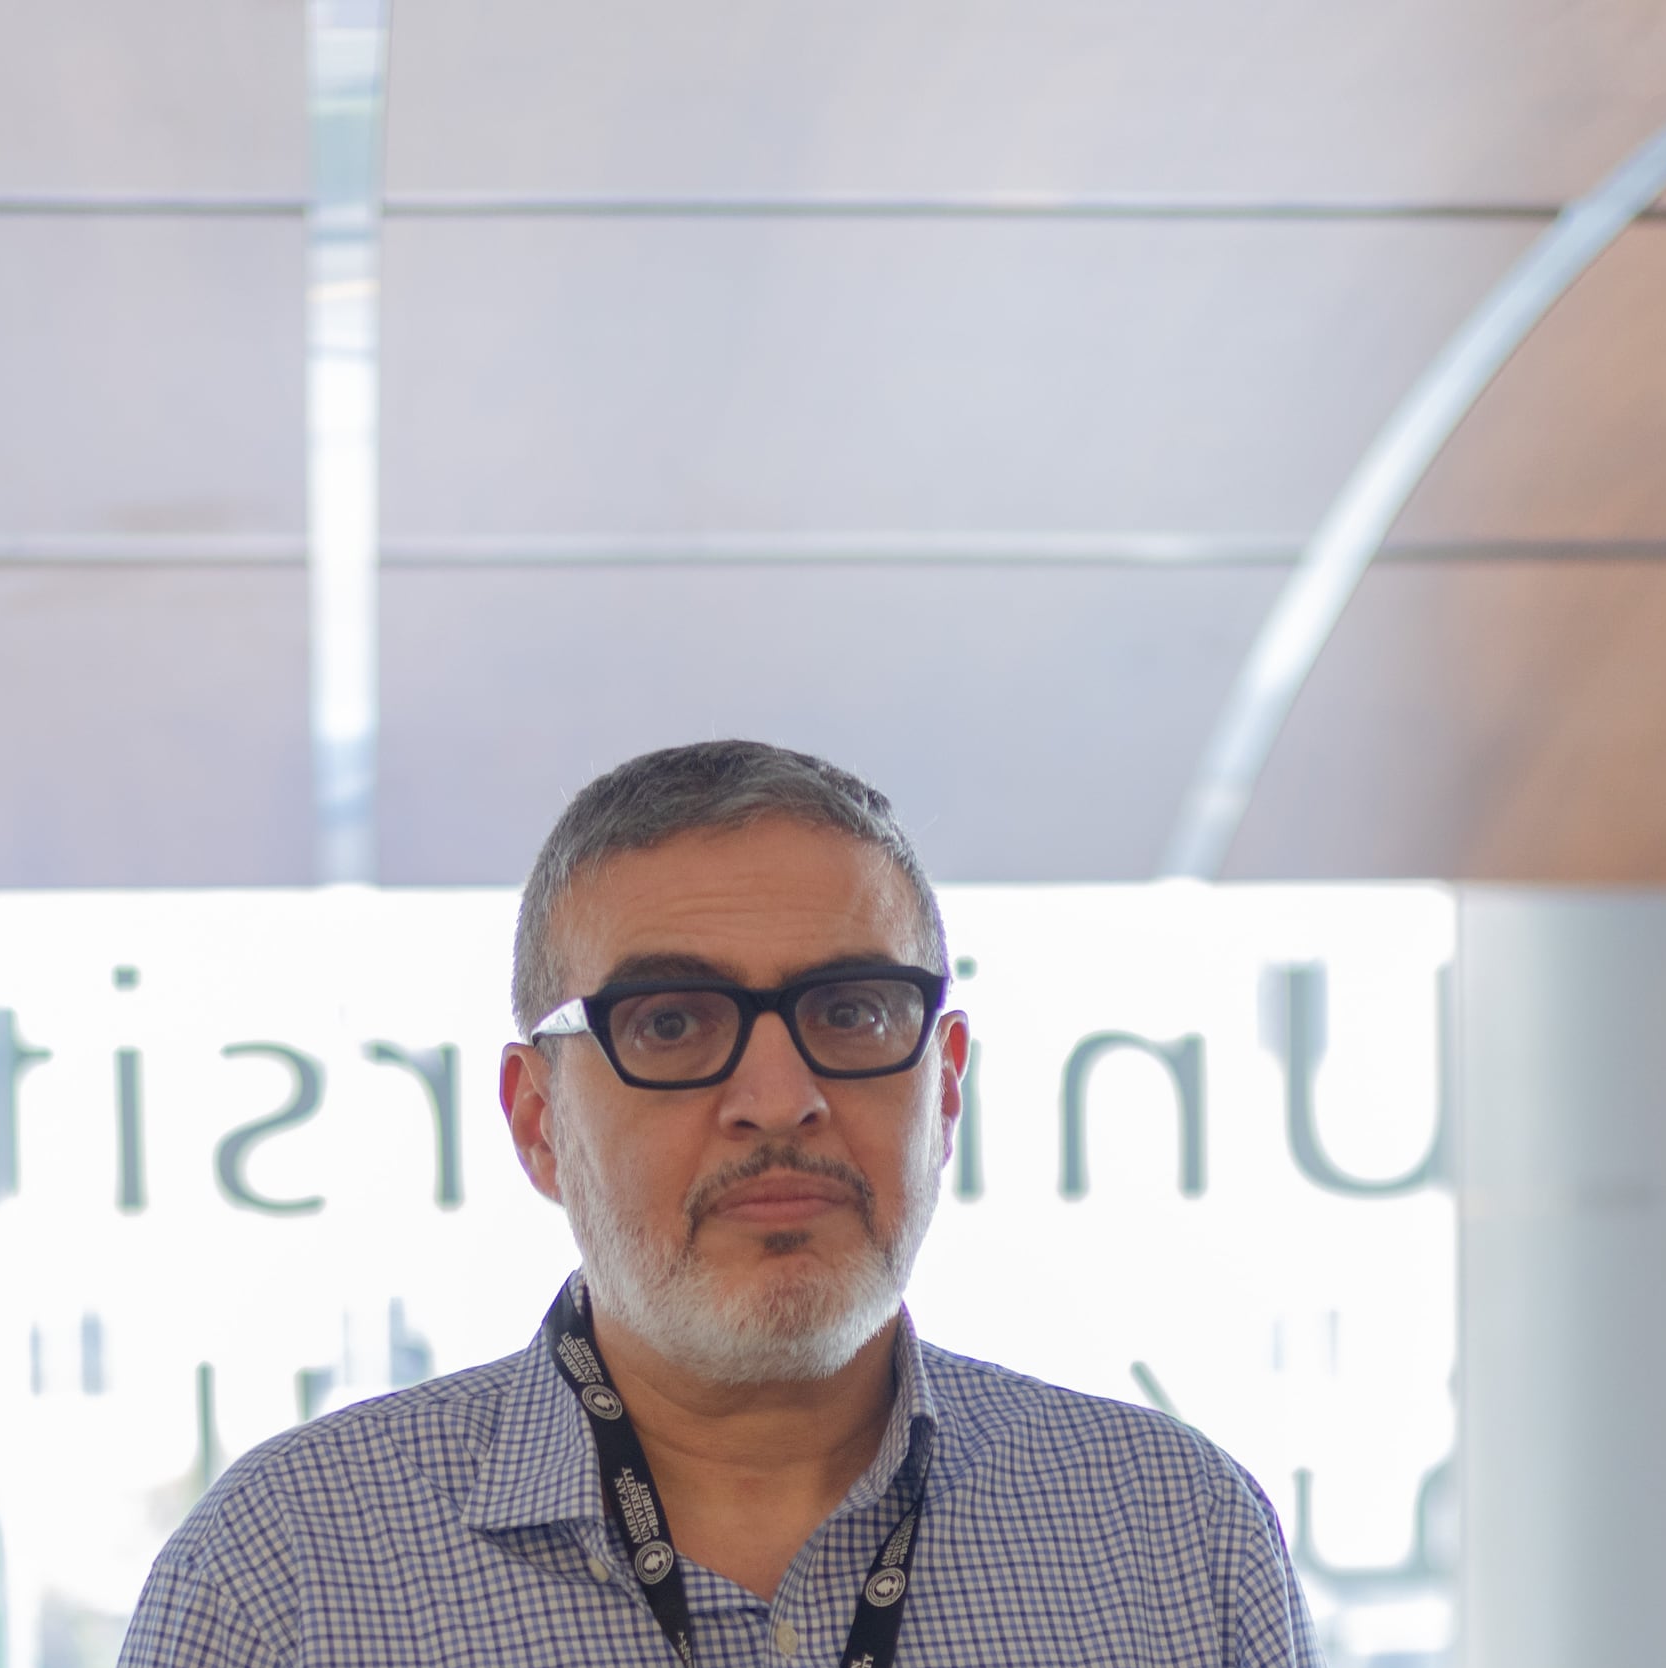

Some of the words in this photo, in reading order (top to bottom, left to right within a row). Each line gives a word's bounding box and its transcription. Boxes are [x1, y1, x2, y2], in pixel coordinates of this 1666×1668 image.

[614, 1477, 643, 1543] AMERICAN
[622, 1467, 651, 1542] UNIVERSITY
[636, 1482, 659, 1529] BEIRUT
